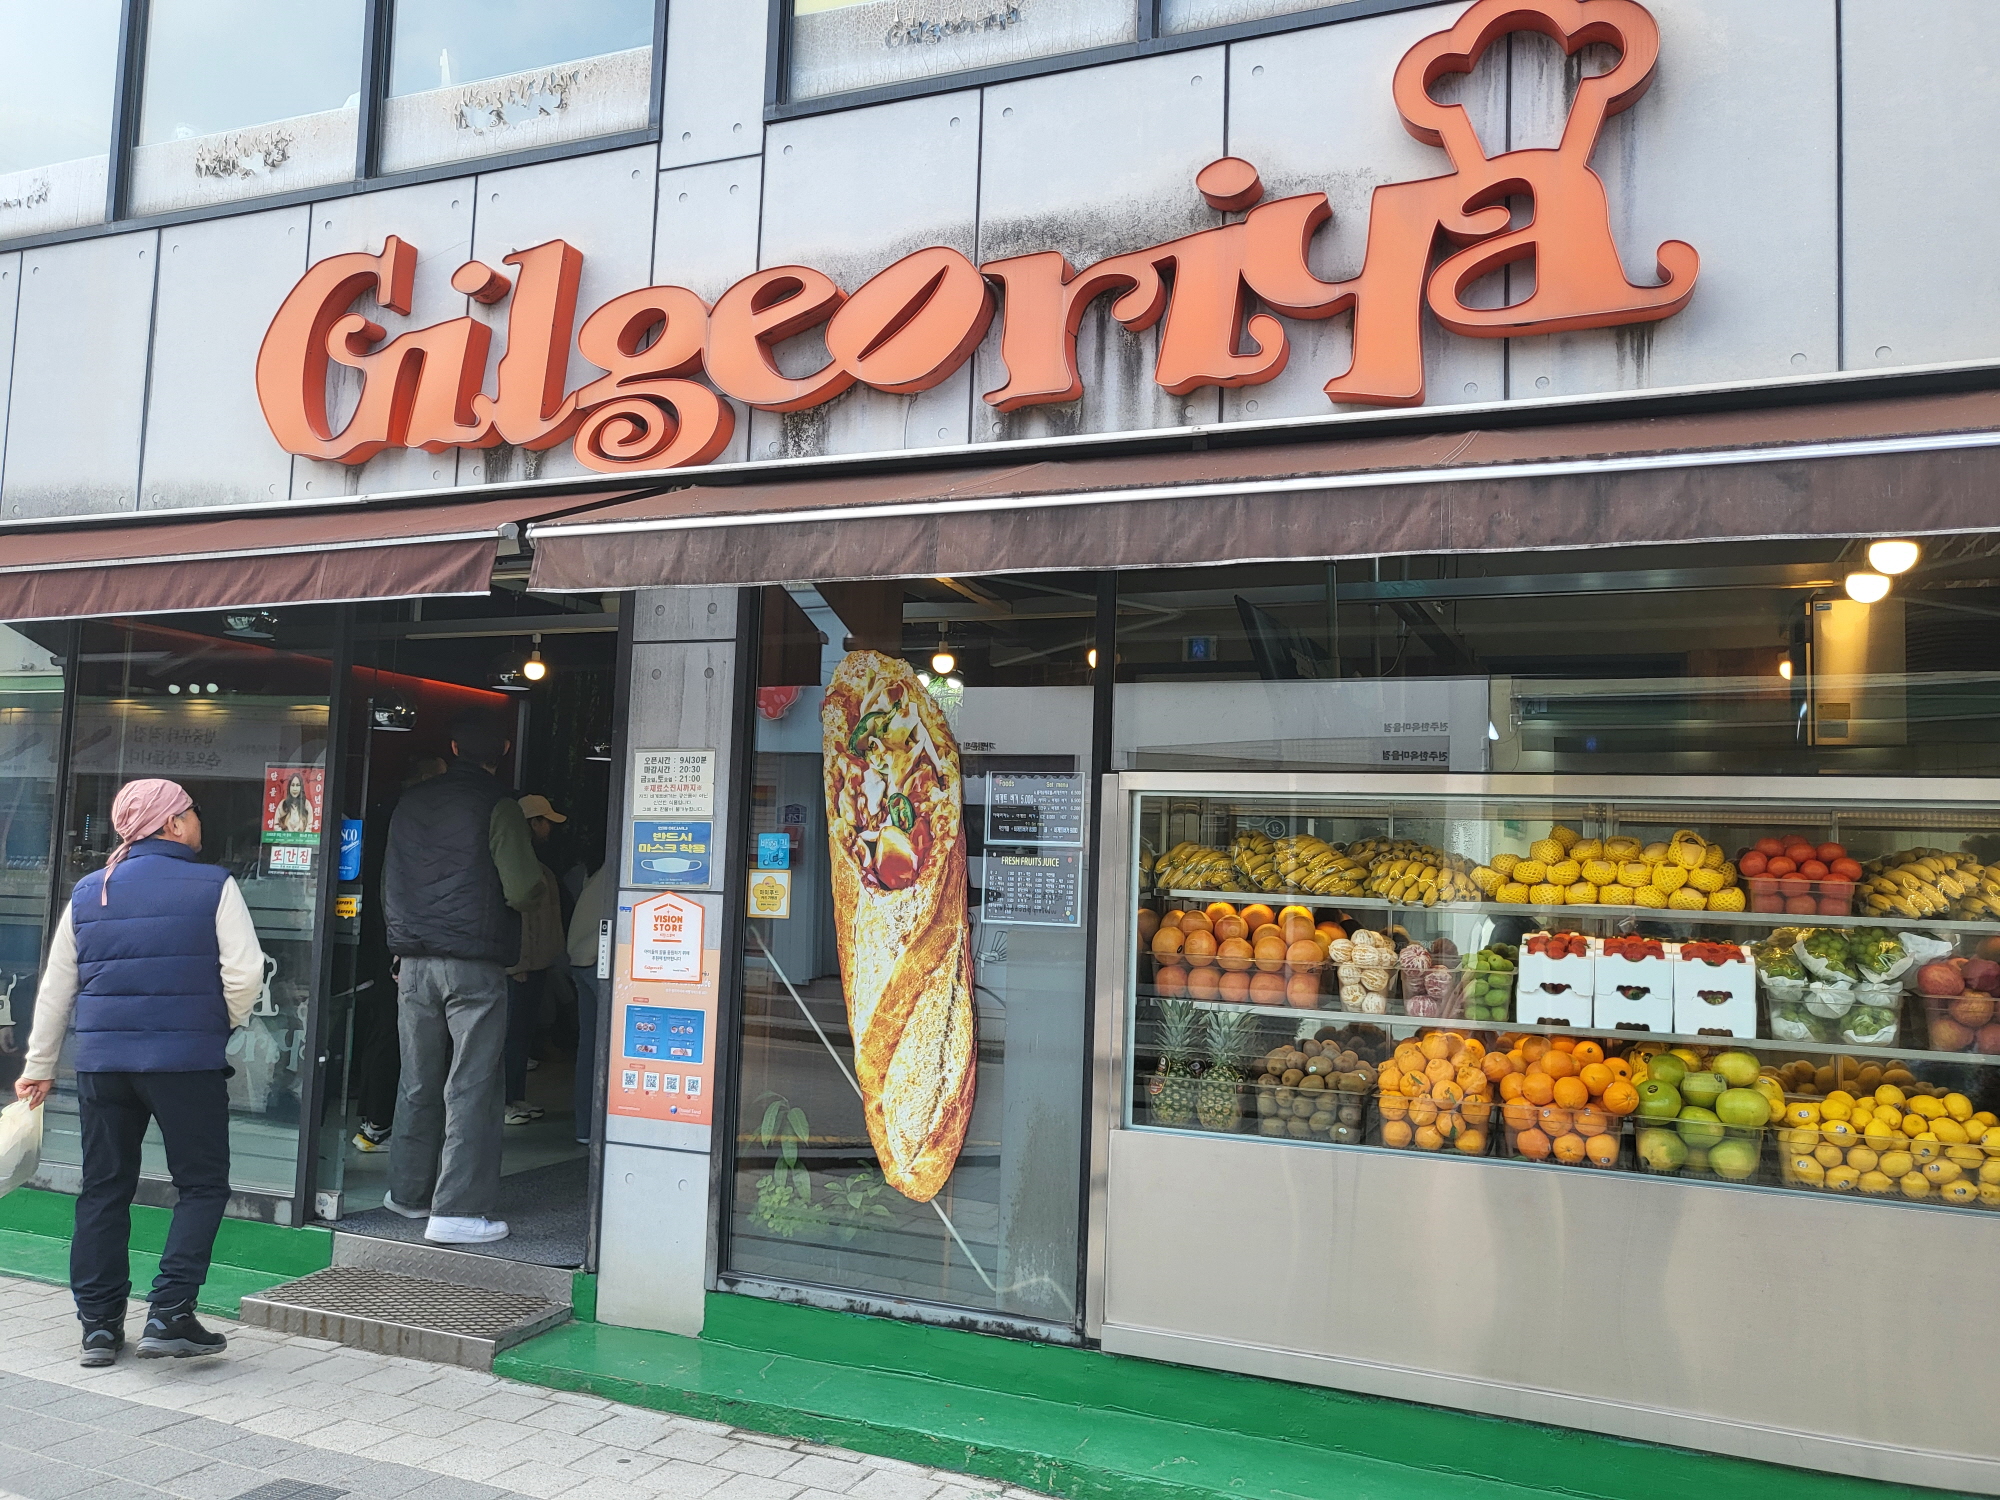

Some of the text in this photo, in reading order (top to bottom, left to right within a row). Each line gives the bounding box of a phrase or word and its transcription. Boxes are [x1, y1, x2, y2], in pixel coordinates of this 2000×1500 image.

[257, 0, 1699, 474] Gilgeoriya
[644, 756, 671, 765] 오픈시간
[679, 755, 707, 764] 9시30분
[643, 765, 671, 774] 마감시간
[679, 765, 701, 773] 20:30
[679, 774, 701, 783] 21:00
[652, 832, 693, 842] 반드시
[638, 843, 706, 854] 마스크 착용
[272, 849, 309, 864] 또간집
[1001, 855, 1060, 867] FRESH FRUITS JUICE
[653, 914, 683, 924] VISION
[652, 923, 683, 932] STORE
